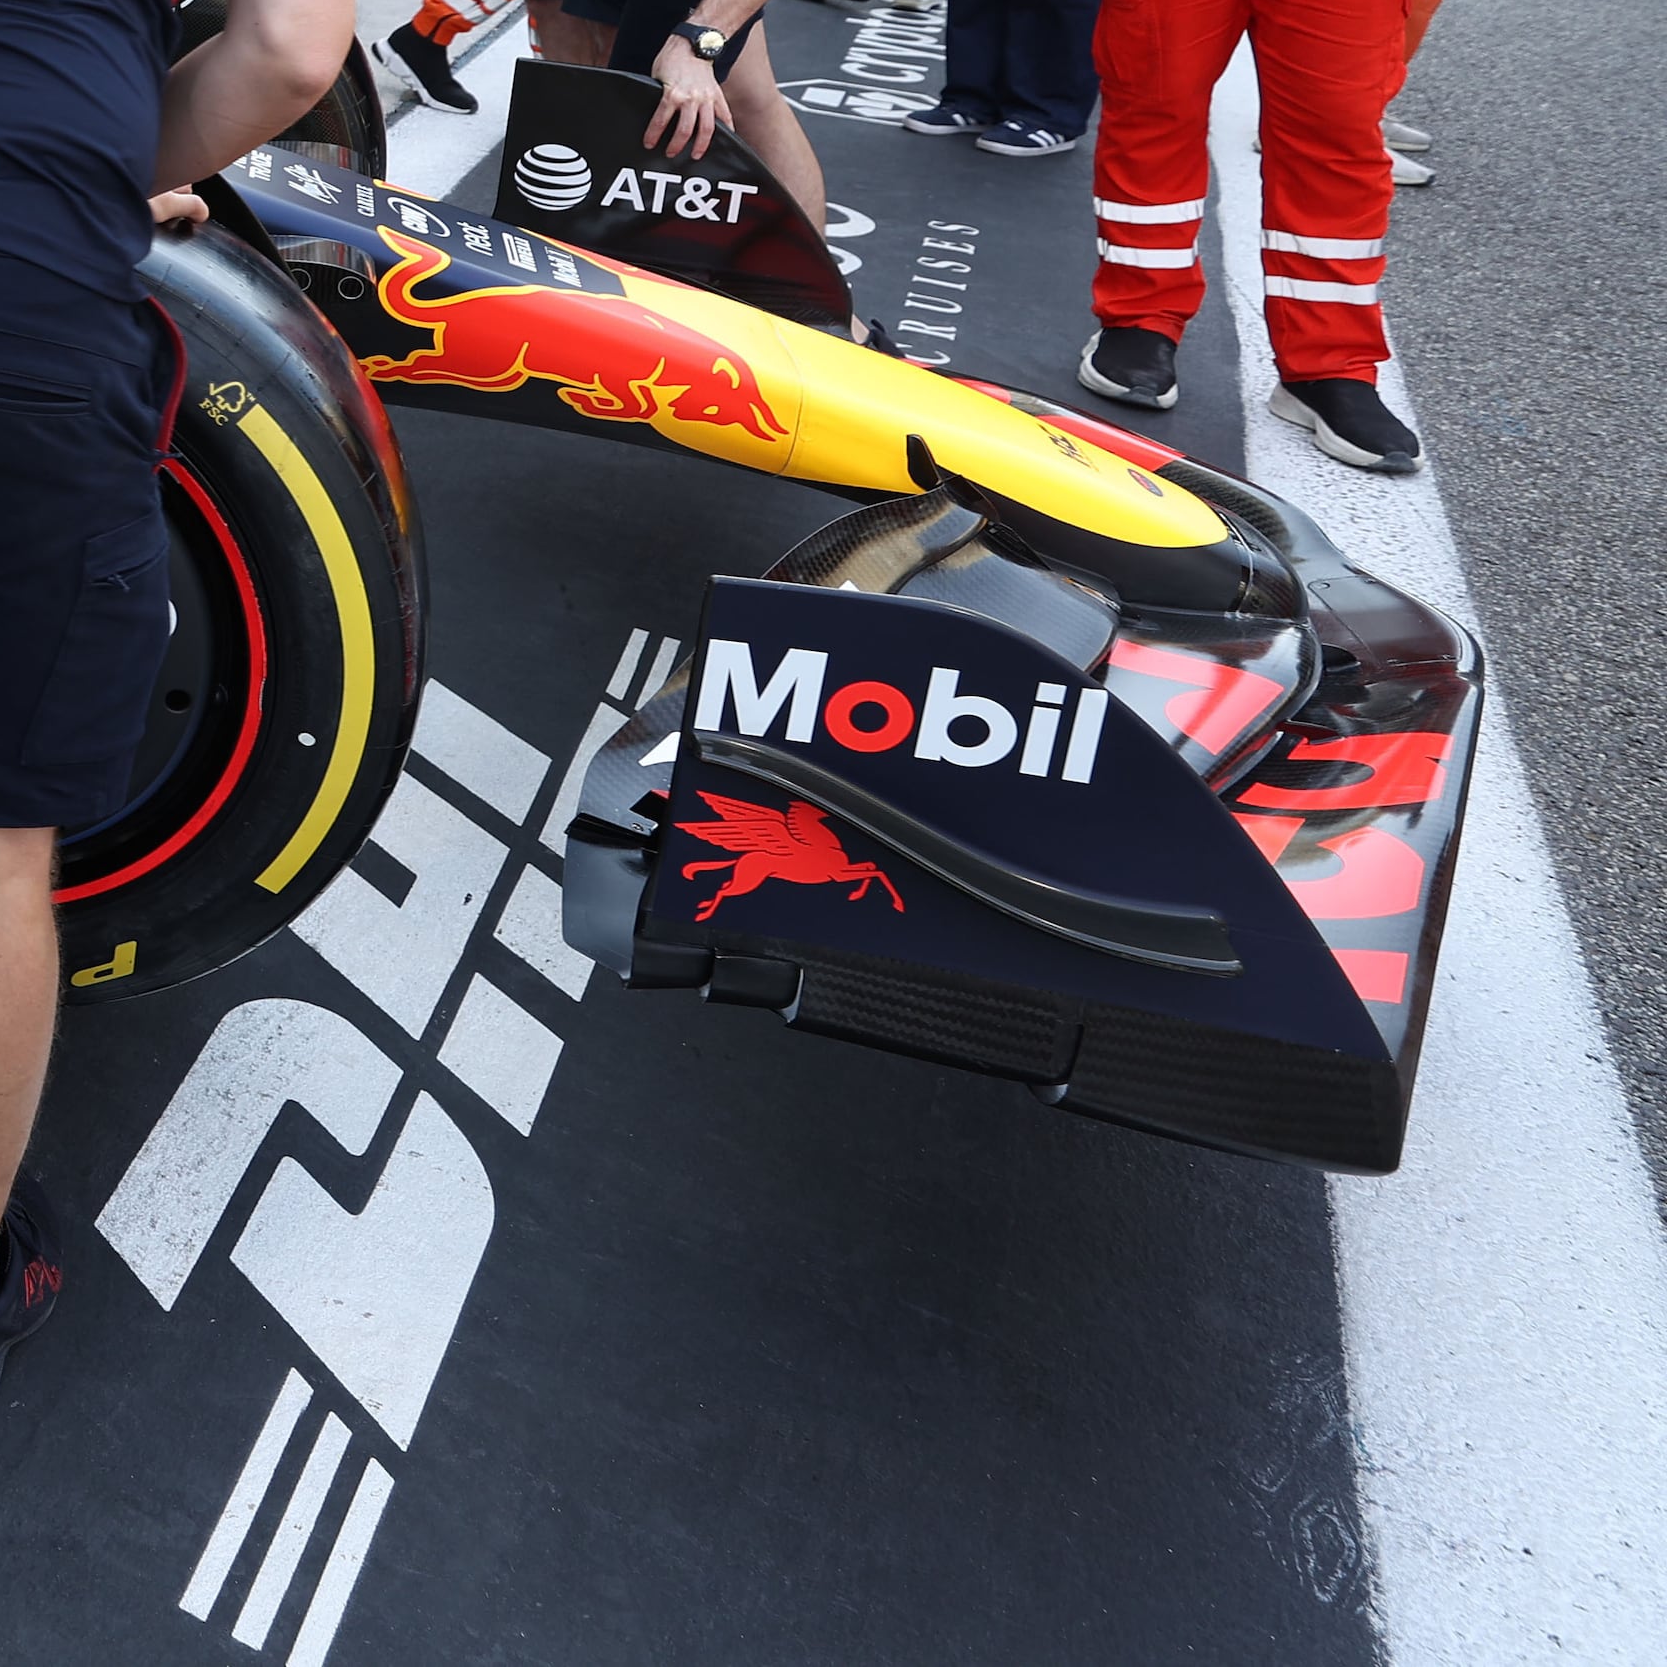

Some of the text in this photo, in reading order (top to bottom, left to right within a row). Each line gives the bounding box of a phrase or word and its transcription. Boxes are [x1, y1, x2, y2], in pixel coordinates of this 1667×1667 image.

[357, 183, 375, 218] CARLYLE
[600, 168, 760, 224] AT&T
[400, 204, 429, 235] CDW
[501, 232, 537, 272] PIRELLI
[552, 254, 582, 288] Mobil
[896, 220, 980, 365] CRUISES
[199, 396, 229, 427] FSC
[692, 638, 1108, 784] Mobil
